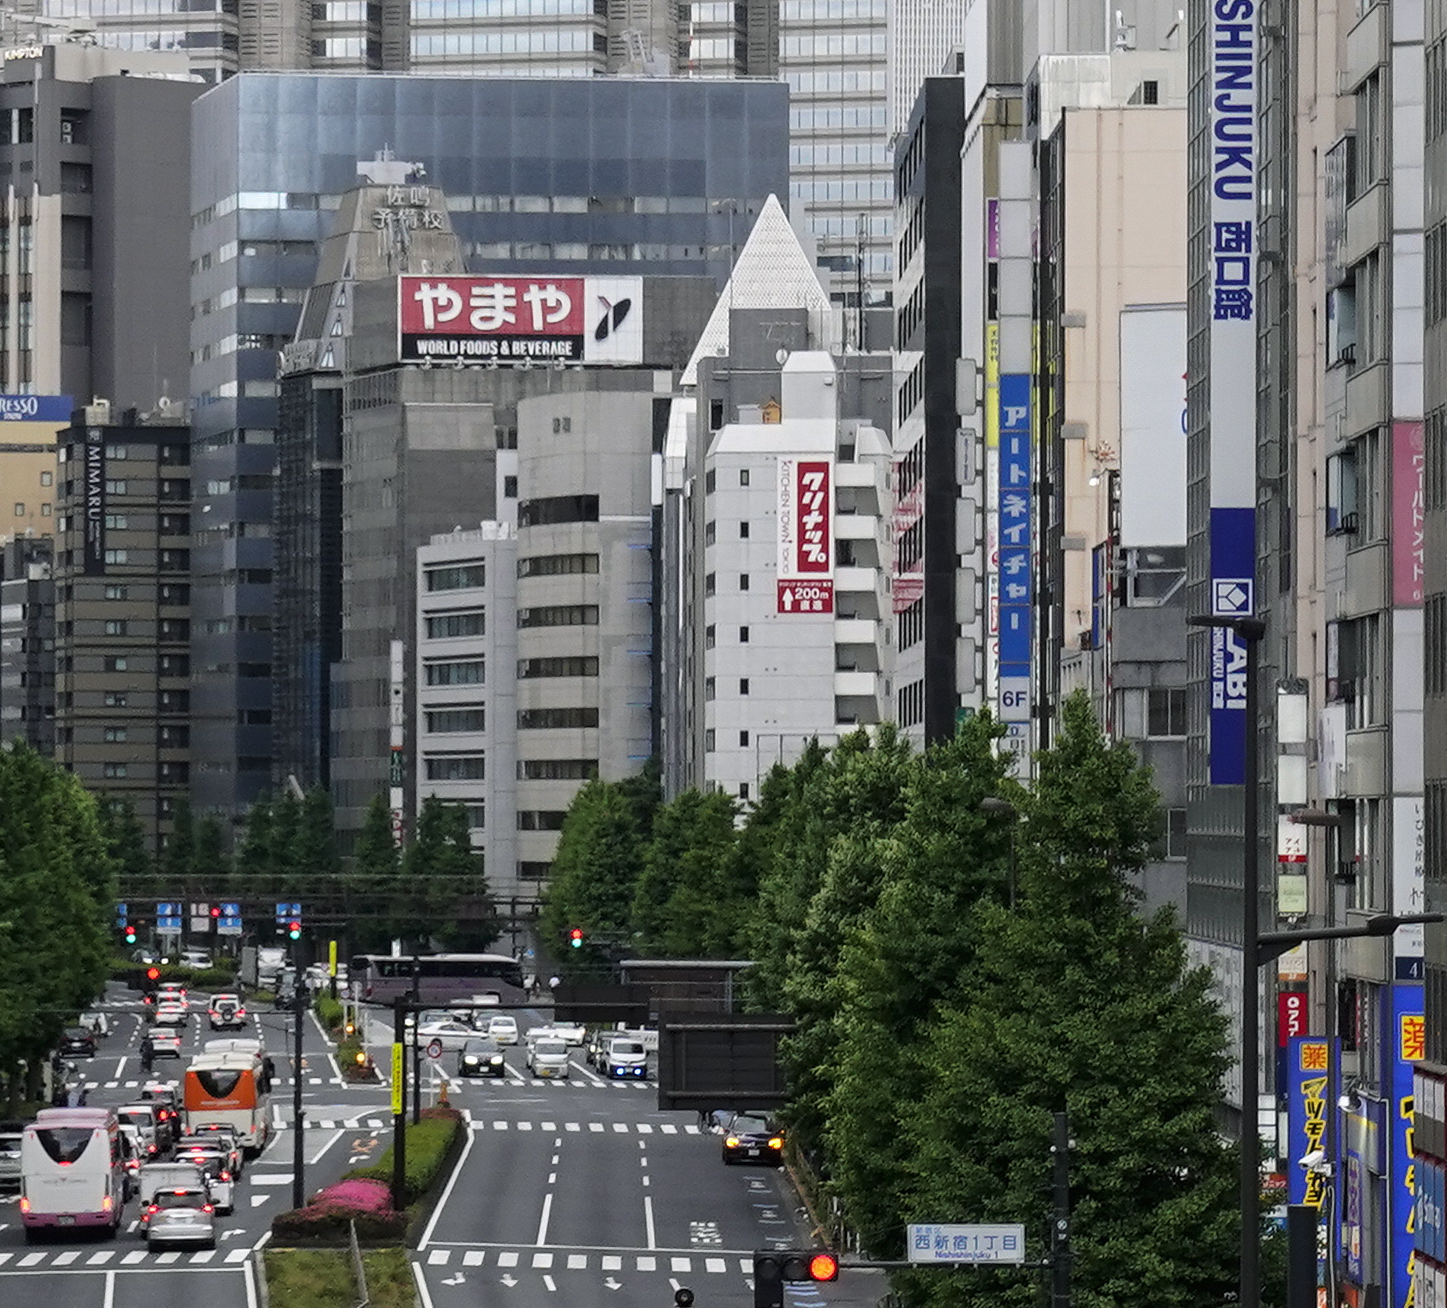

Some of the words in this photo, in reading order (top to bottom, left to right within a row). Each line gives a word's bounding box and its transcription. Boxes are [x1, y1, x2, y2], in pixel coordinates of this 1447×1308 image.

[1213, 219, 1253, 322] 西口館
[415, 282, 572, 332] やまや
[417, 340, 459, 357] WORLD
[460, 340, 498, 357] FOODS
[512, 340, 573, 357] BEVERAGE
[88, 445, 102, 522] MIMARU
[799, 471, 827, 565] クリナップ
[1002, 406, 1028, 631] アートネイチャー
[794, 586, 829, 601] 200m
[1002, 689, 1028, 707] 6F
[914, 1234, 1018, 1251] 西新宿1丁目
